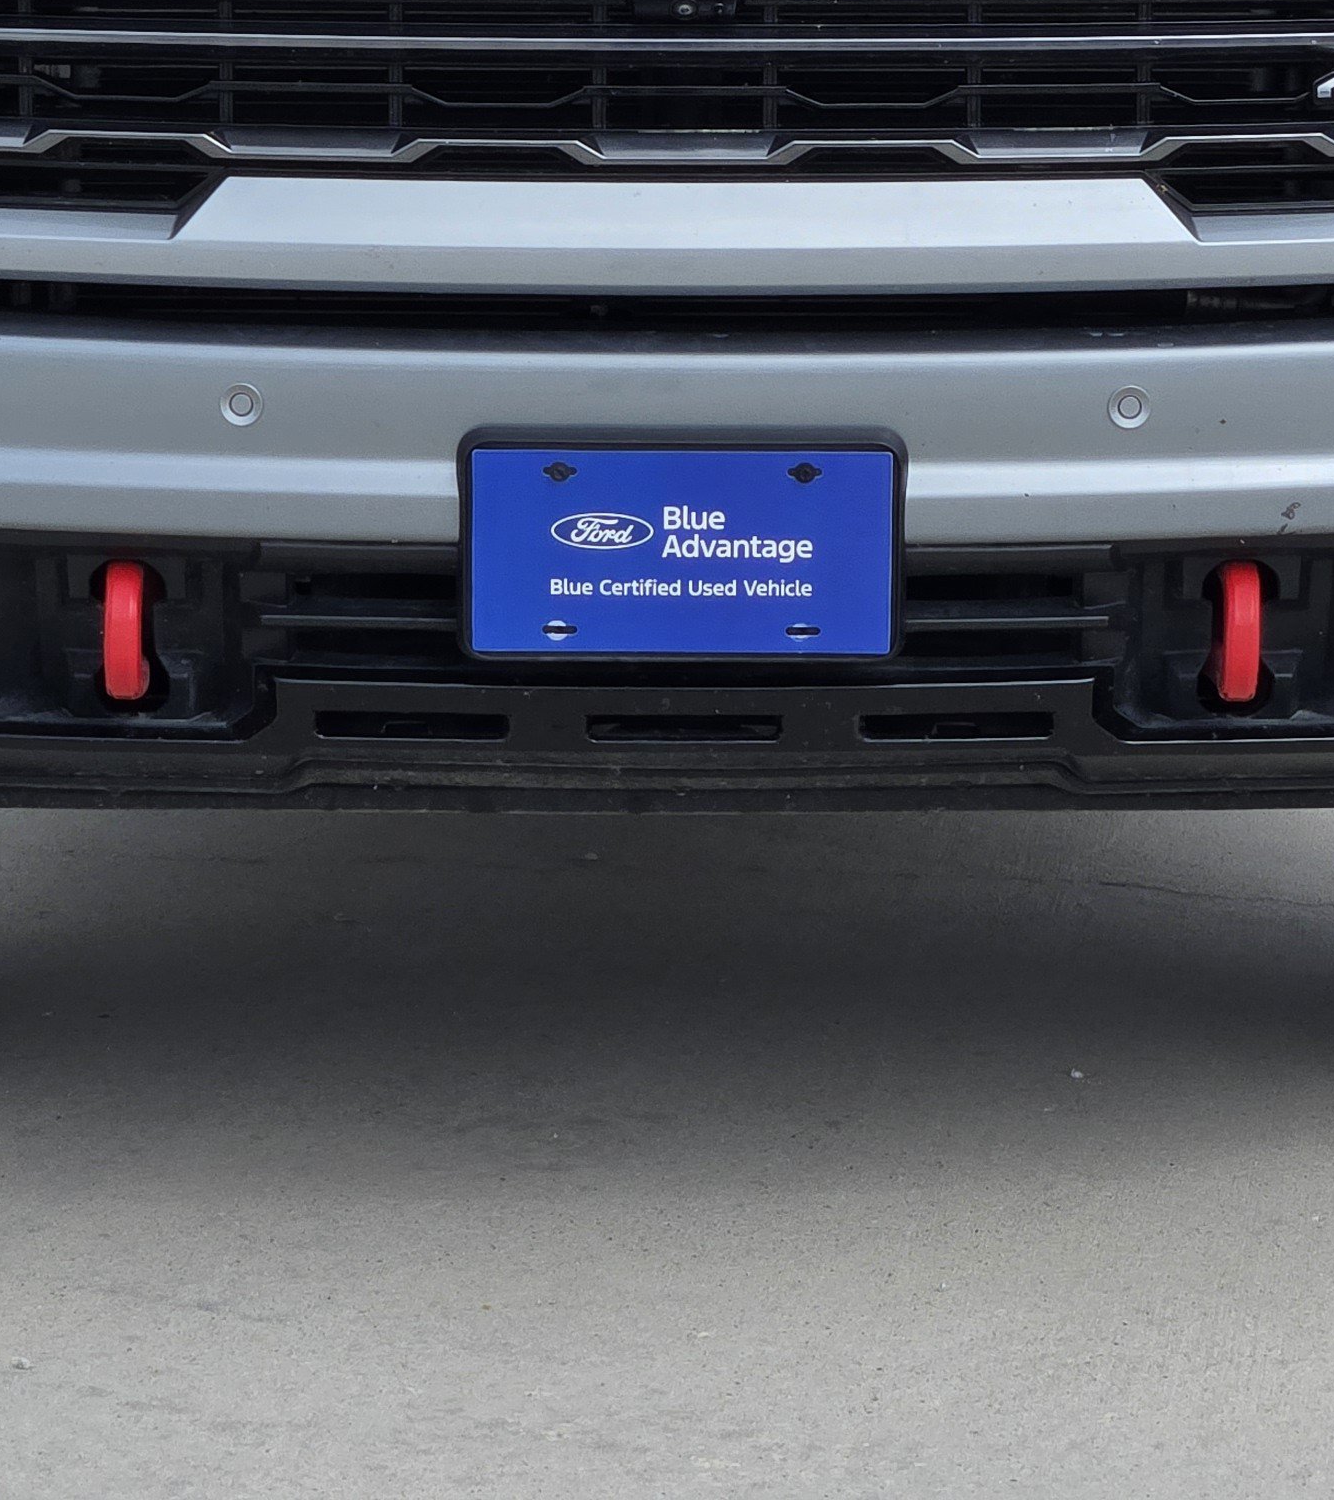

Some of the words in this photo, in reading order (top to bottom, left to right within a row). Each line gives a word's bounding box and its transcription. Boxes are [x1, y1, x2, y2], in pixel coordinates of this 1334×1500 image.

[662, 505, 726, 531] Blue
[661, 534, 814, 563] Advantage
[550, 578, 594, 596] Blue
[598, 578, 682, 597] Certified
[687, 578, 738, 597] Used
[743, 579, 814, 597] Vehicle
